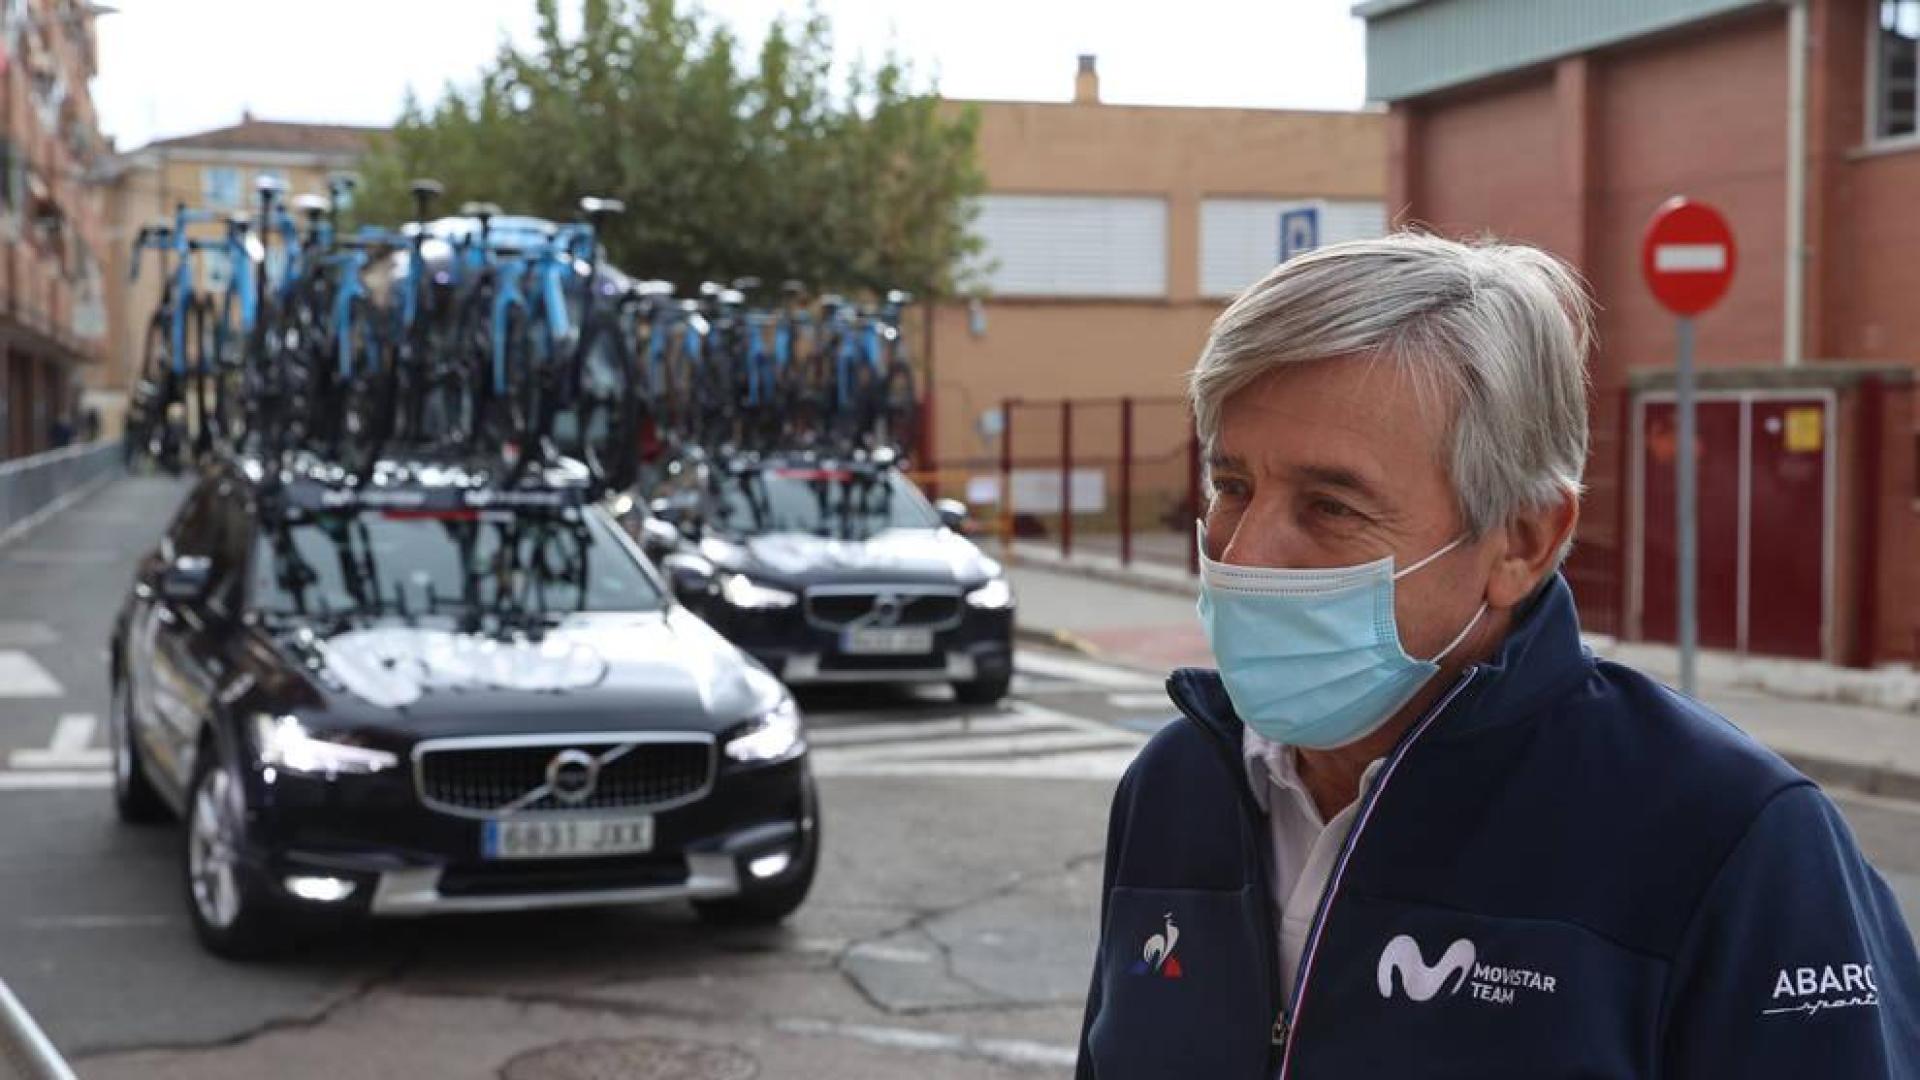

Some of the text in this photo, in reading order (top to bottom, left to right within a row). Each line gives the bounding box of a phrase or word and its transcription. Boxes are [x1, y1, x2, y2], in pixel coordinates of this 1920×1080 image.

[503, 821, 577, 850] 6831
[1473, 962, 1556, 993] MOVISTAR
[1471, 981, 1514, 1004] TEAM
